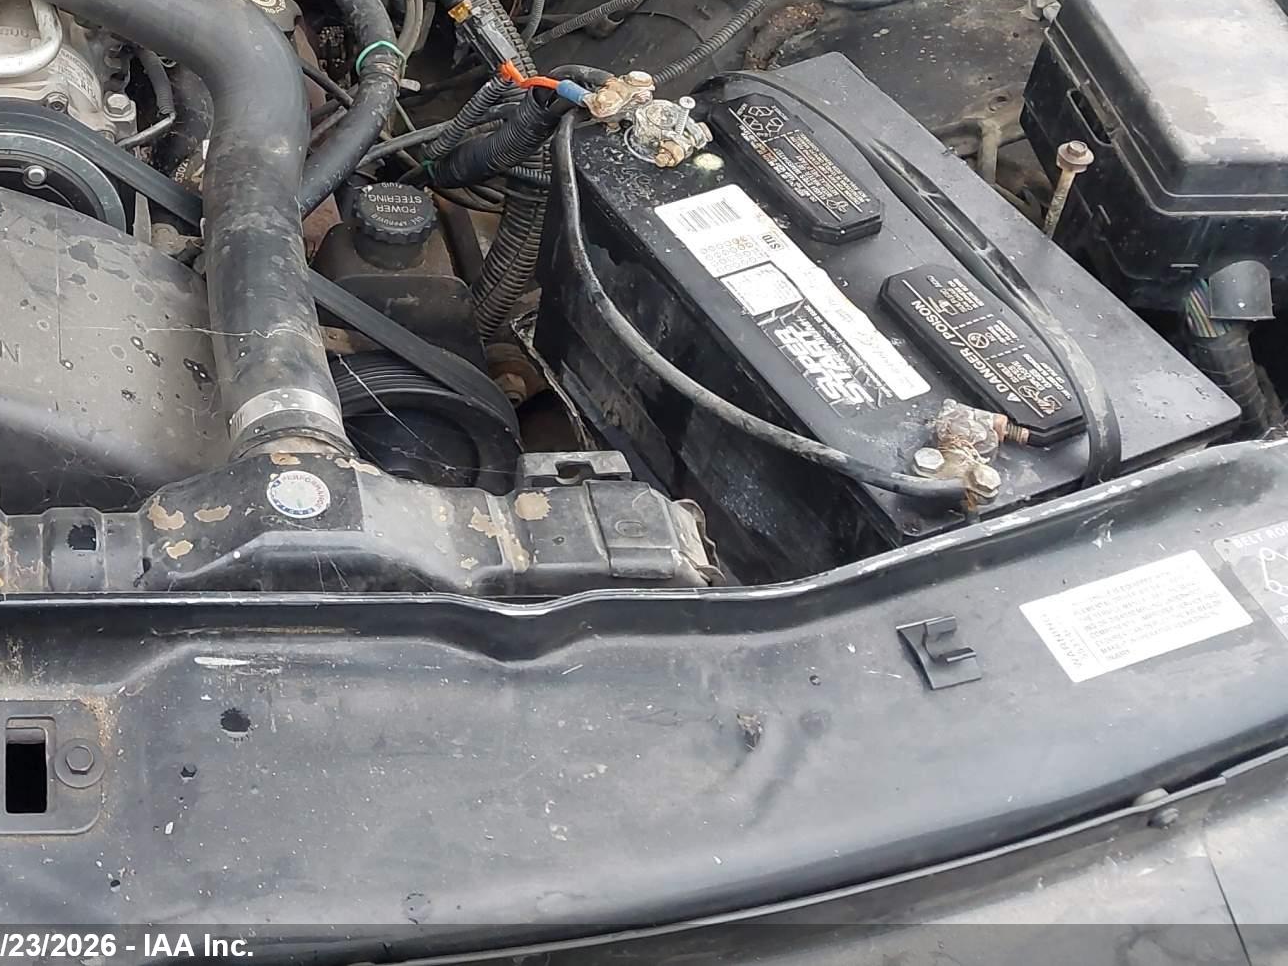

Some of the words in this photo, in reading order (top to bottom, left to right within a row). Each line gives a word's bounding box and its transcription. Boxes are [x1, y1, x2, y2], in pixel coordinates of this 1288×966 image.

[367, 194, 422, 204] STEERING
[376, 204, 417, 214] POWER
[911, 300, 956, 341] POISON
[774, 325, 842, 400] SUPER
[785, 320, 875, 403] START
[959, 347, 1010, 393] DANGER
[1232, 533, 1264, 549] BELT
